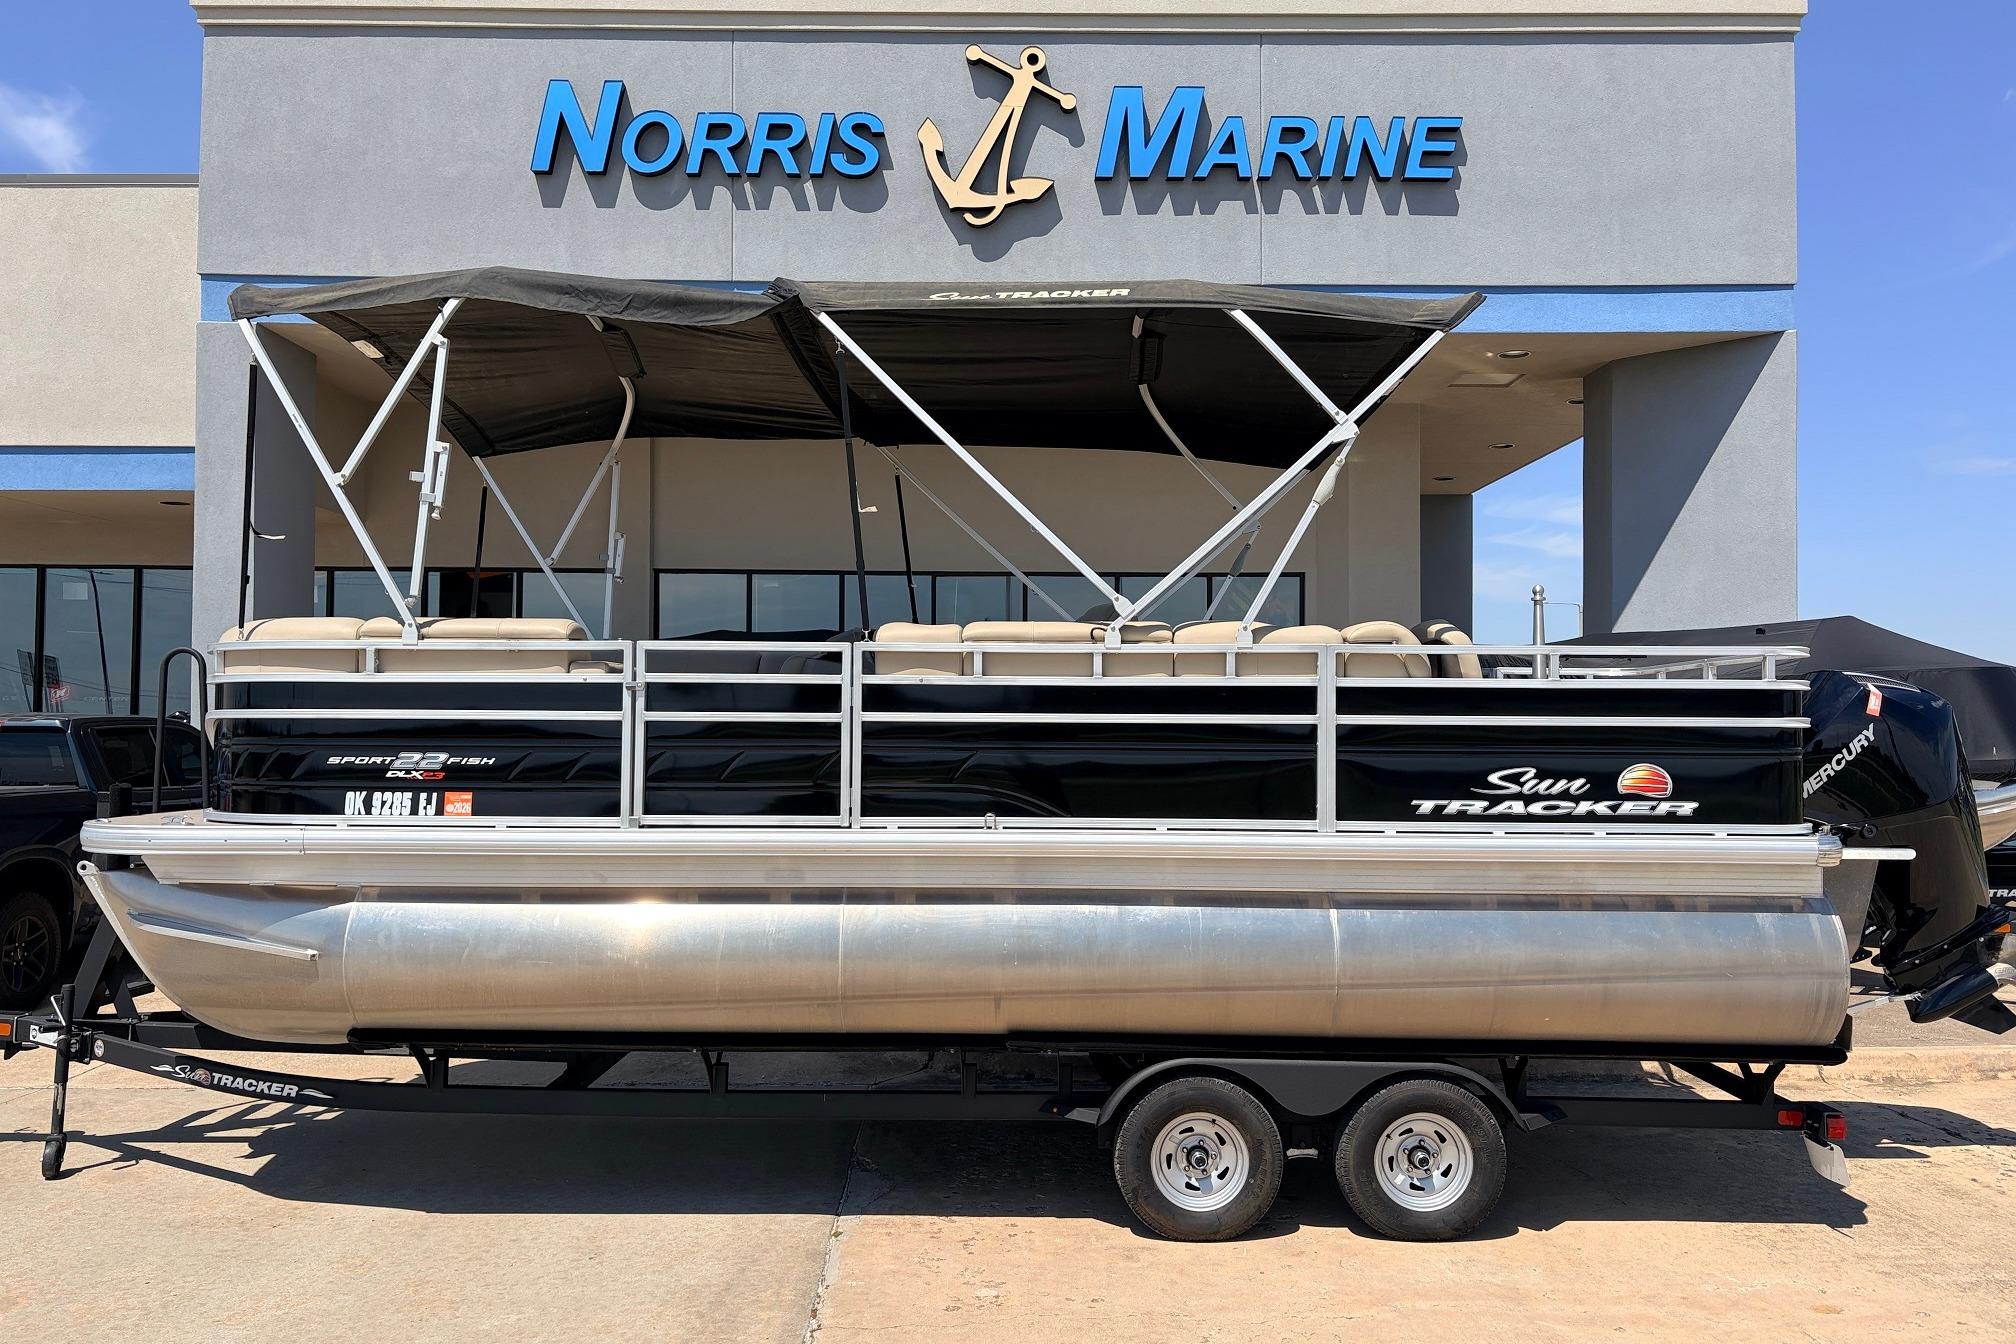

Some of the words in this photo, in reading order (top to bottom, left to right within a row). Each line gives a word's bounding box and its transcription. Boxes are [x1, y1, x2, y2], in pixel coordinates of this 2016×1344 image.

[530, 79, 885, 179] NORRIS
[1095, 85, 1463, 182] MARINE
[996, 288, 1131, 300] TRACKER
[327, 756, 396, 764] SPORT
[390, 752, 449, 769] 22
[447, 757, 495, 765] FISH
[1470, 766, 1591, 795] Sun
[344, 791, 367, 816] OK
[371, 791, 412, 816] 9285
[418, 792, 437, 816] EJ
[452, 801, 472, 814] 2026
[1411, 800, 1700, 816] TRACKER
[212, 1073, 299, 1097] TRACKER
